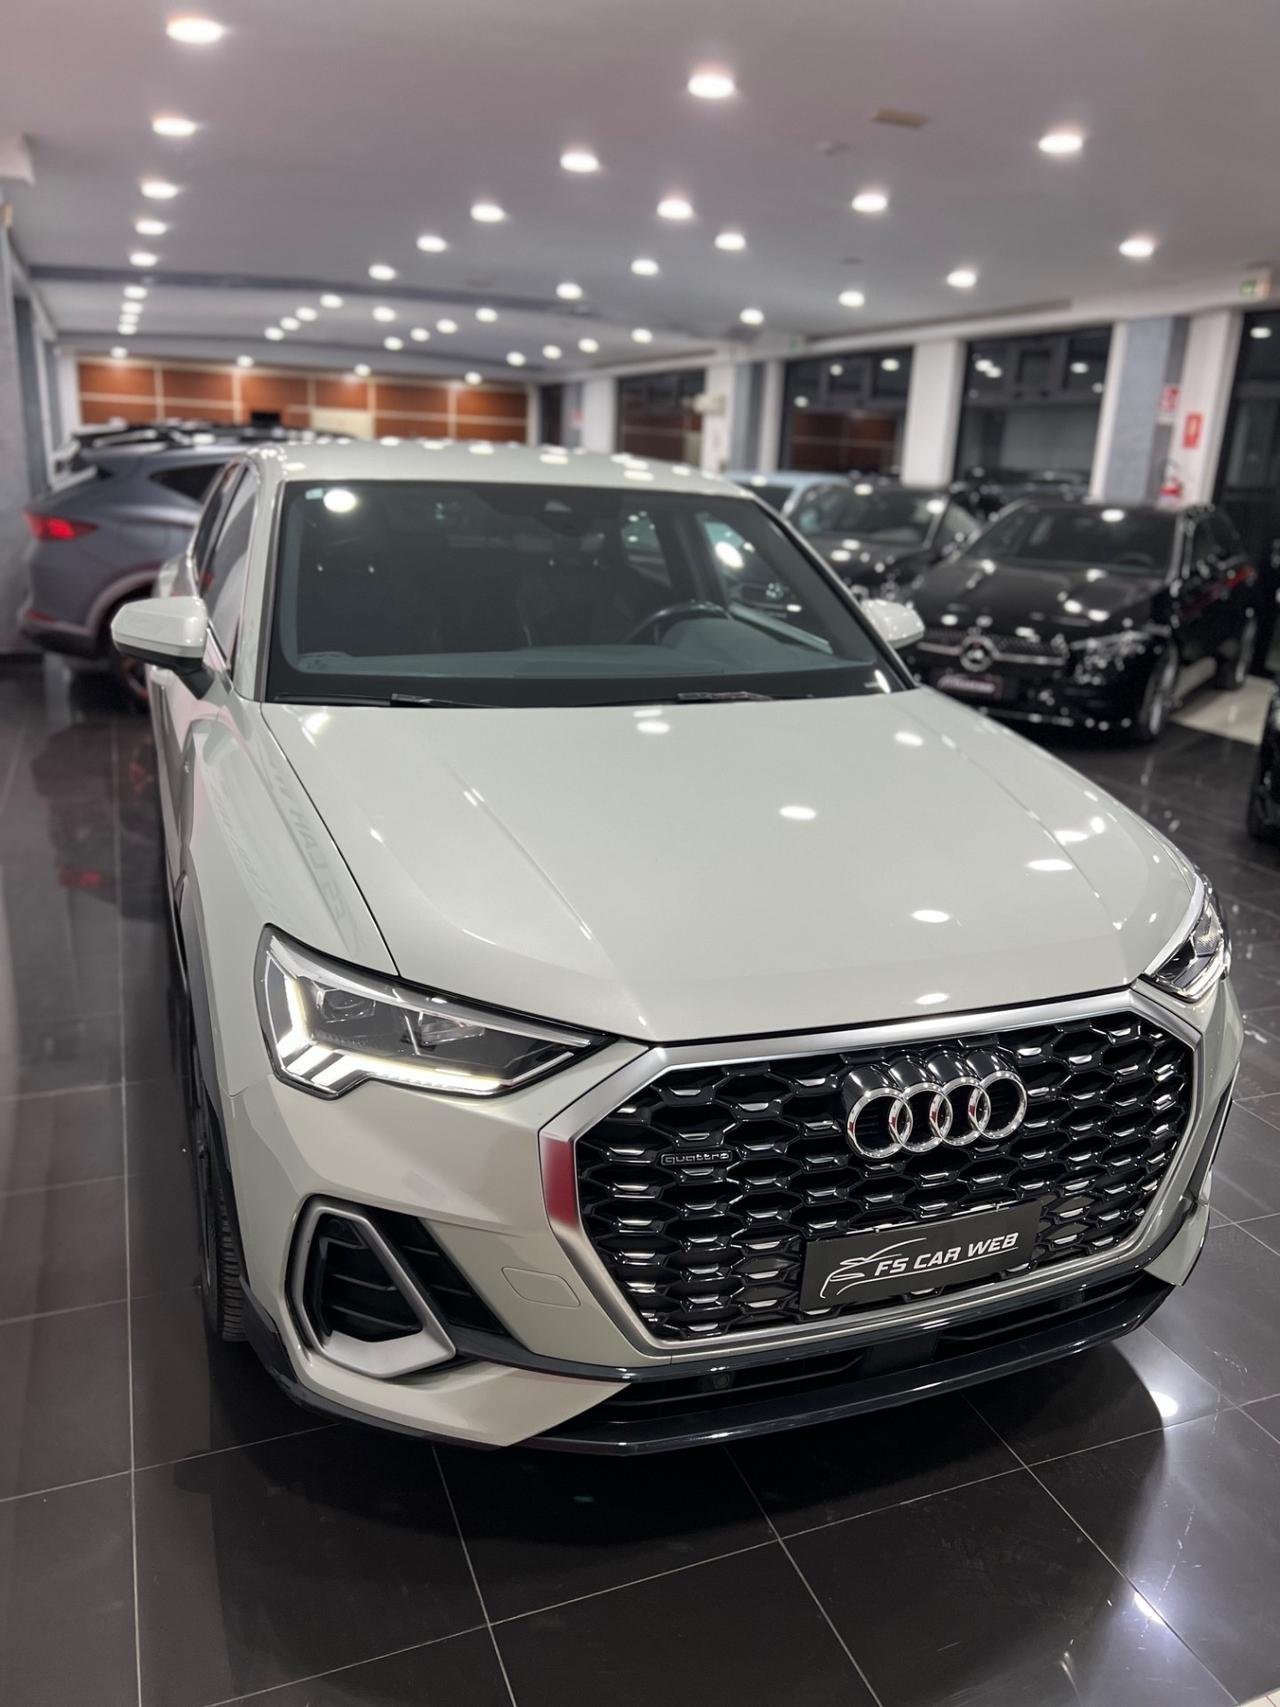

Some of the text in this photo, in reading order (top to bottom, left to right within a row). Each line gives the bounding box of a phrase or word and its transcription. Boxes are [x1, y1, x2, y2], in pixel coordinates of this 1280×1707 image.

[663, 1151, 730, 1165] quattro
[874, 1232, 1019, 1277] FS CAR WEB
